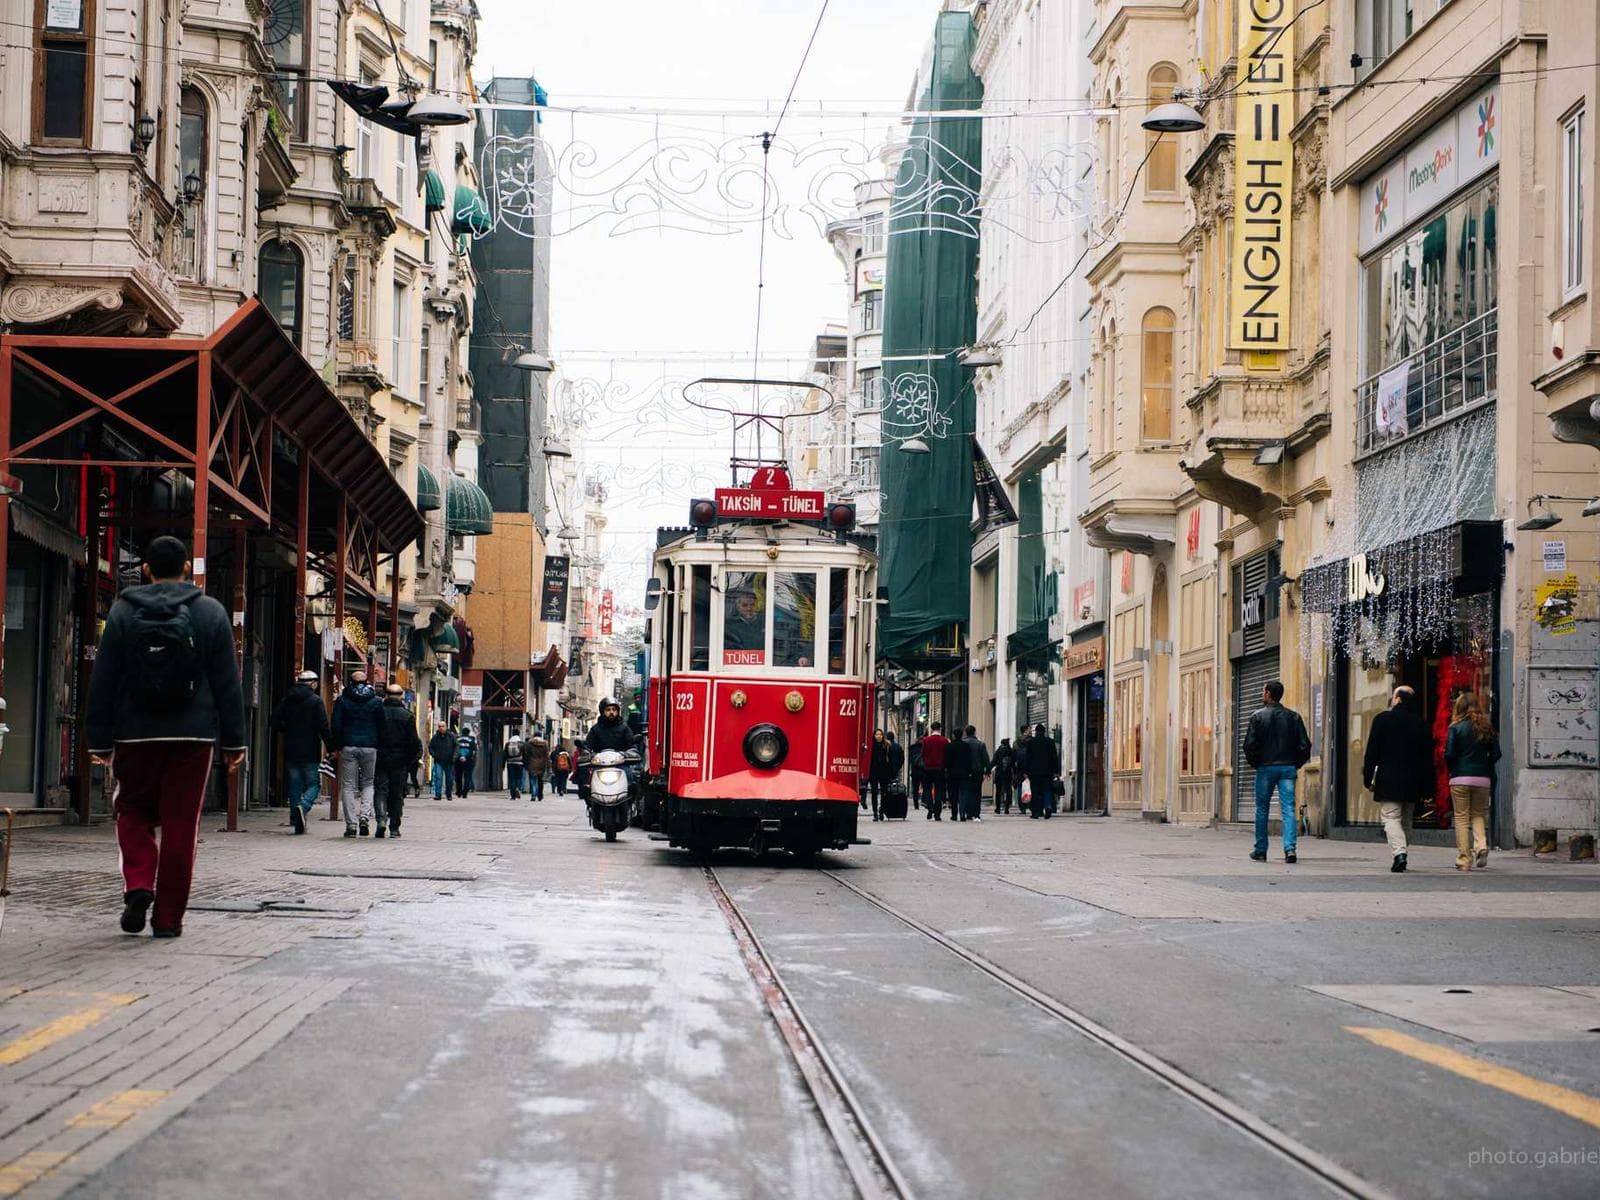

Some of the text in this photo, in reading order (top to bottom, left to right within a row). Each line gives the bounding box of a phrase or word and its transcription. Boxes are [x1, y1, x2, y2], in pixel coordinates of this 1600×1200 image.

[1248, 0, 1284, 83] ENG
[1243, 160, 1282, 342] ENGLISH
[766, 468, 775, 486] 2
[720, 493, 762, 512] TAKSİM
[781, 495, 821, 514] TÜNEL
[676, 693, 694, 710] 223
[839, 698, 856, 716] 223
